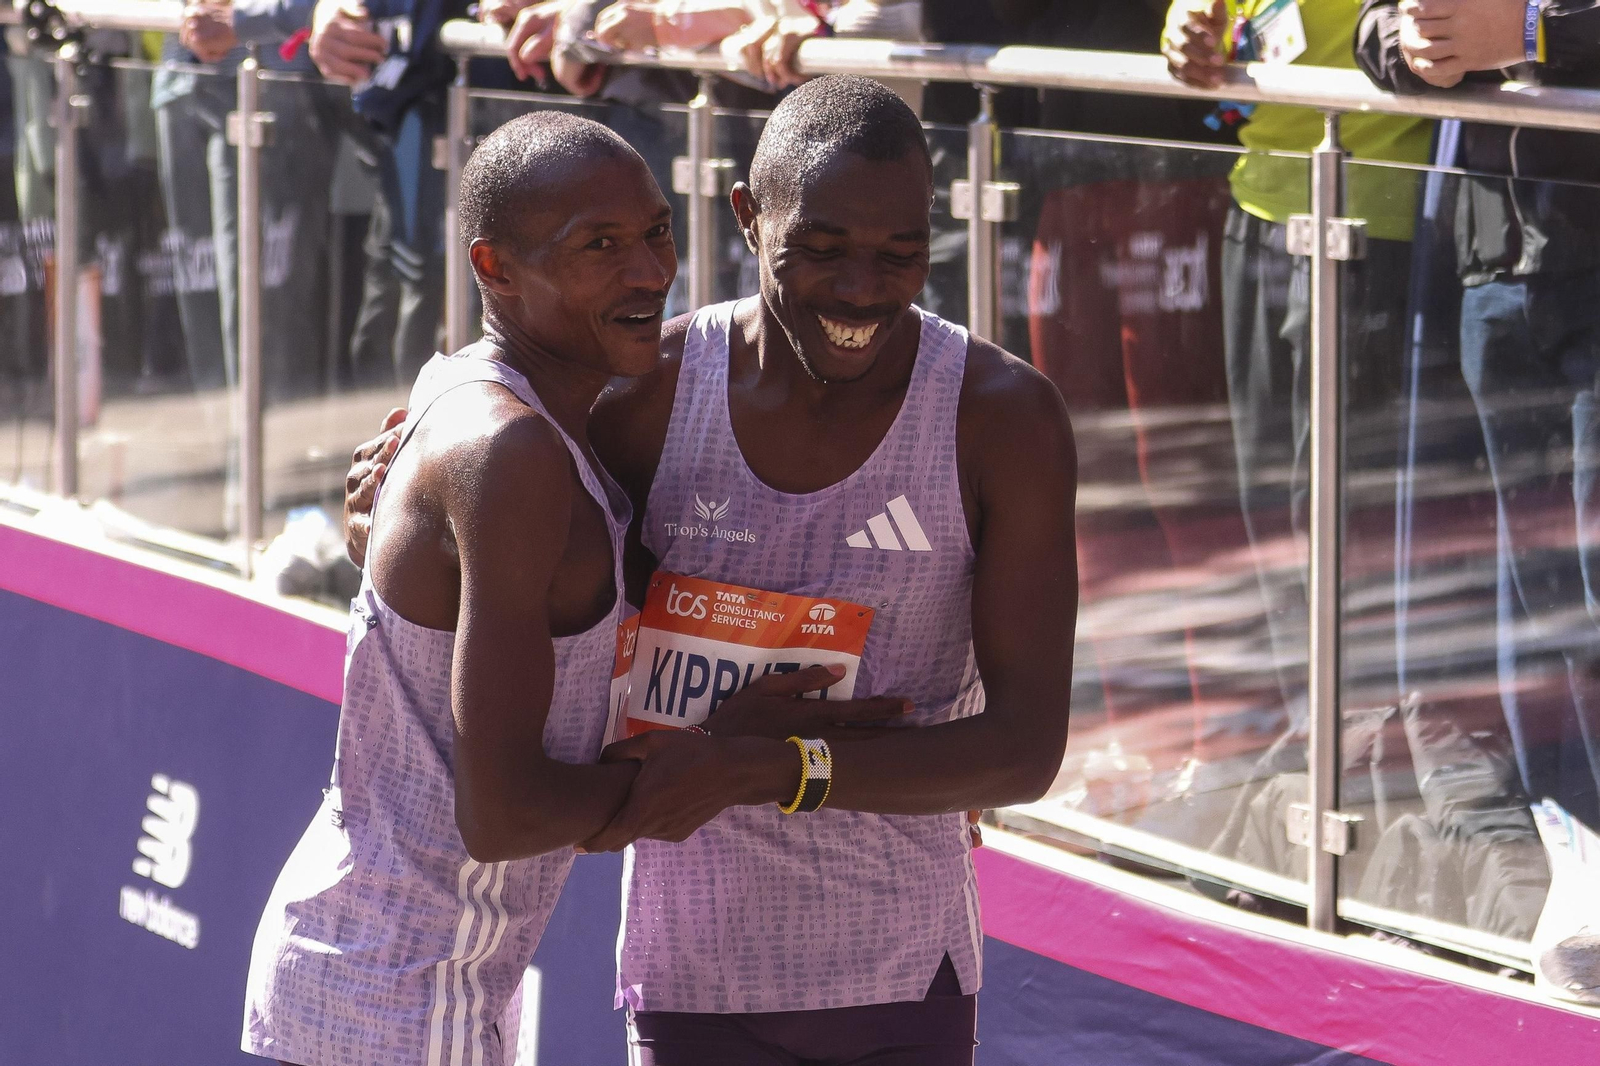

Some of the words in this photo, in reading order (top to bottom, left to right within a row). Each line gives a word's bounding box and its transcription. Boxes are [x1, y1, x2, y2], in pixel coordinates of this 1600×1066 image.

[1525, 4, 1537, 42] BBOTT
[664, 523, 709, 540] Tiop's
[710, 525, 756, 543] Angels
[666, 583, 709, 620] tcs
[715, 591, 746, 605] TATA
[711, 613, 757, 630] SERVICES
[713, 602, 785, 622] CONSULTANCY
[801, 624, 835, 636] TATA
[643, 646, 828, 718] KIPR
